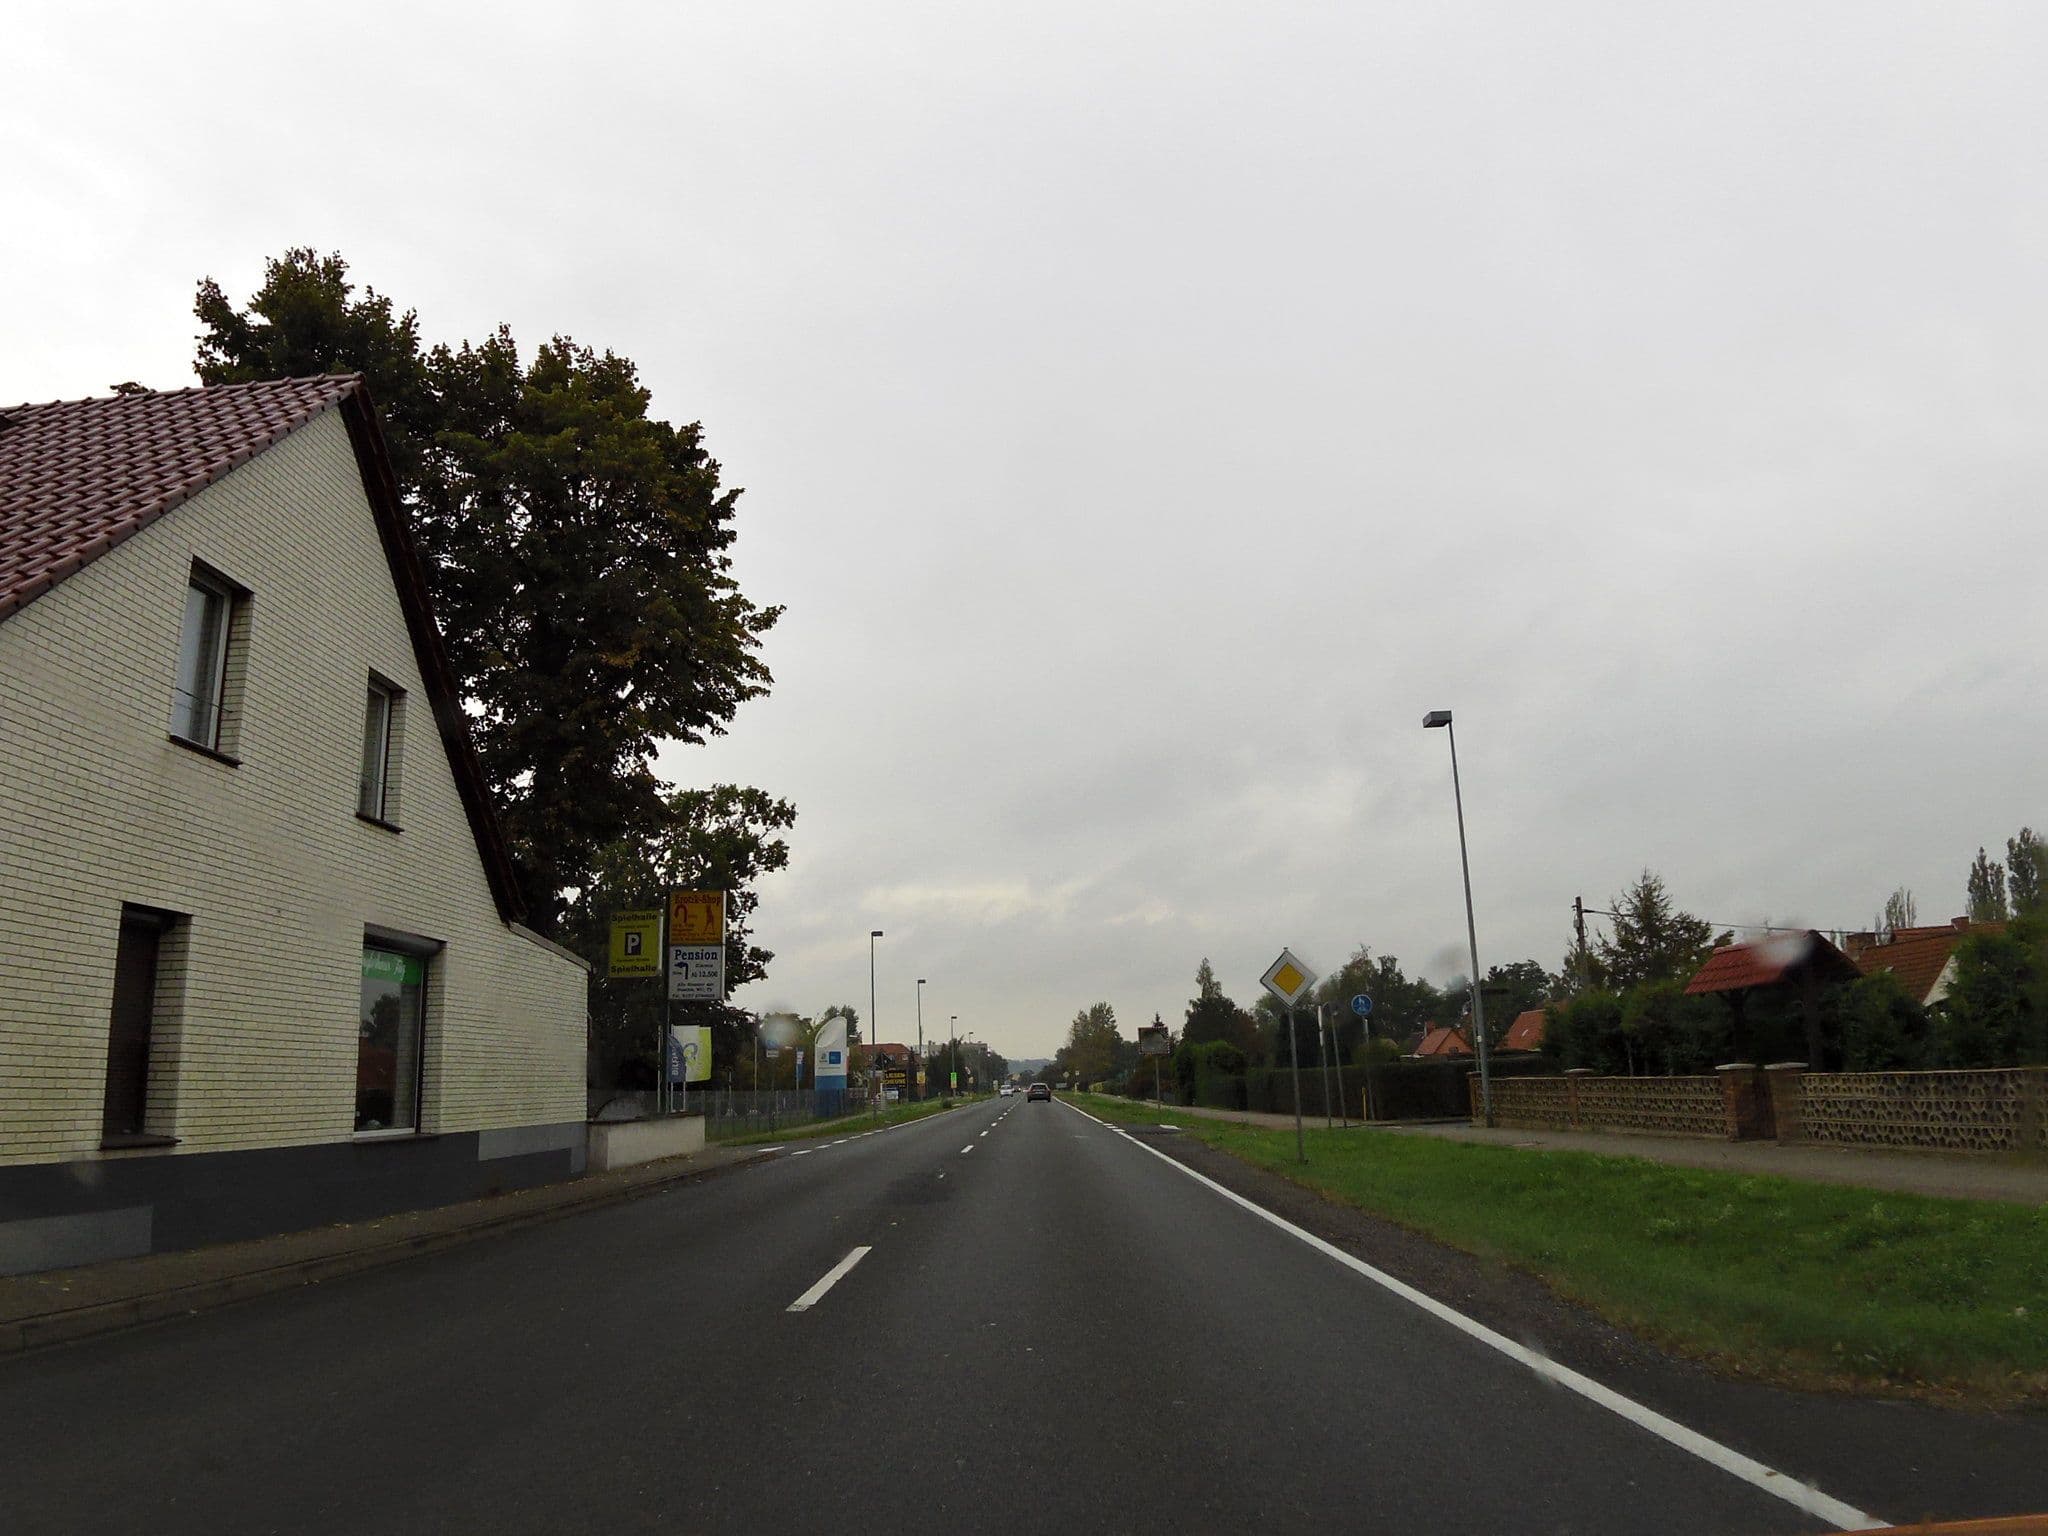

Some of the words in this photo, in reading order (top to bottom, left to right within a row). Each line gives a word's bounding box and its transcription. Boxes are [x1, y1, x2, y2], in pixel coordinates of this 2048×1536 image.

[611, 913, 657, 923] Spielhalle
[627, 934, 640, 954] P
[674, 949, 718, 960] Pension
[611, 965, 657, 974] Spielhalle
